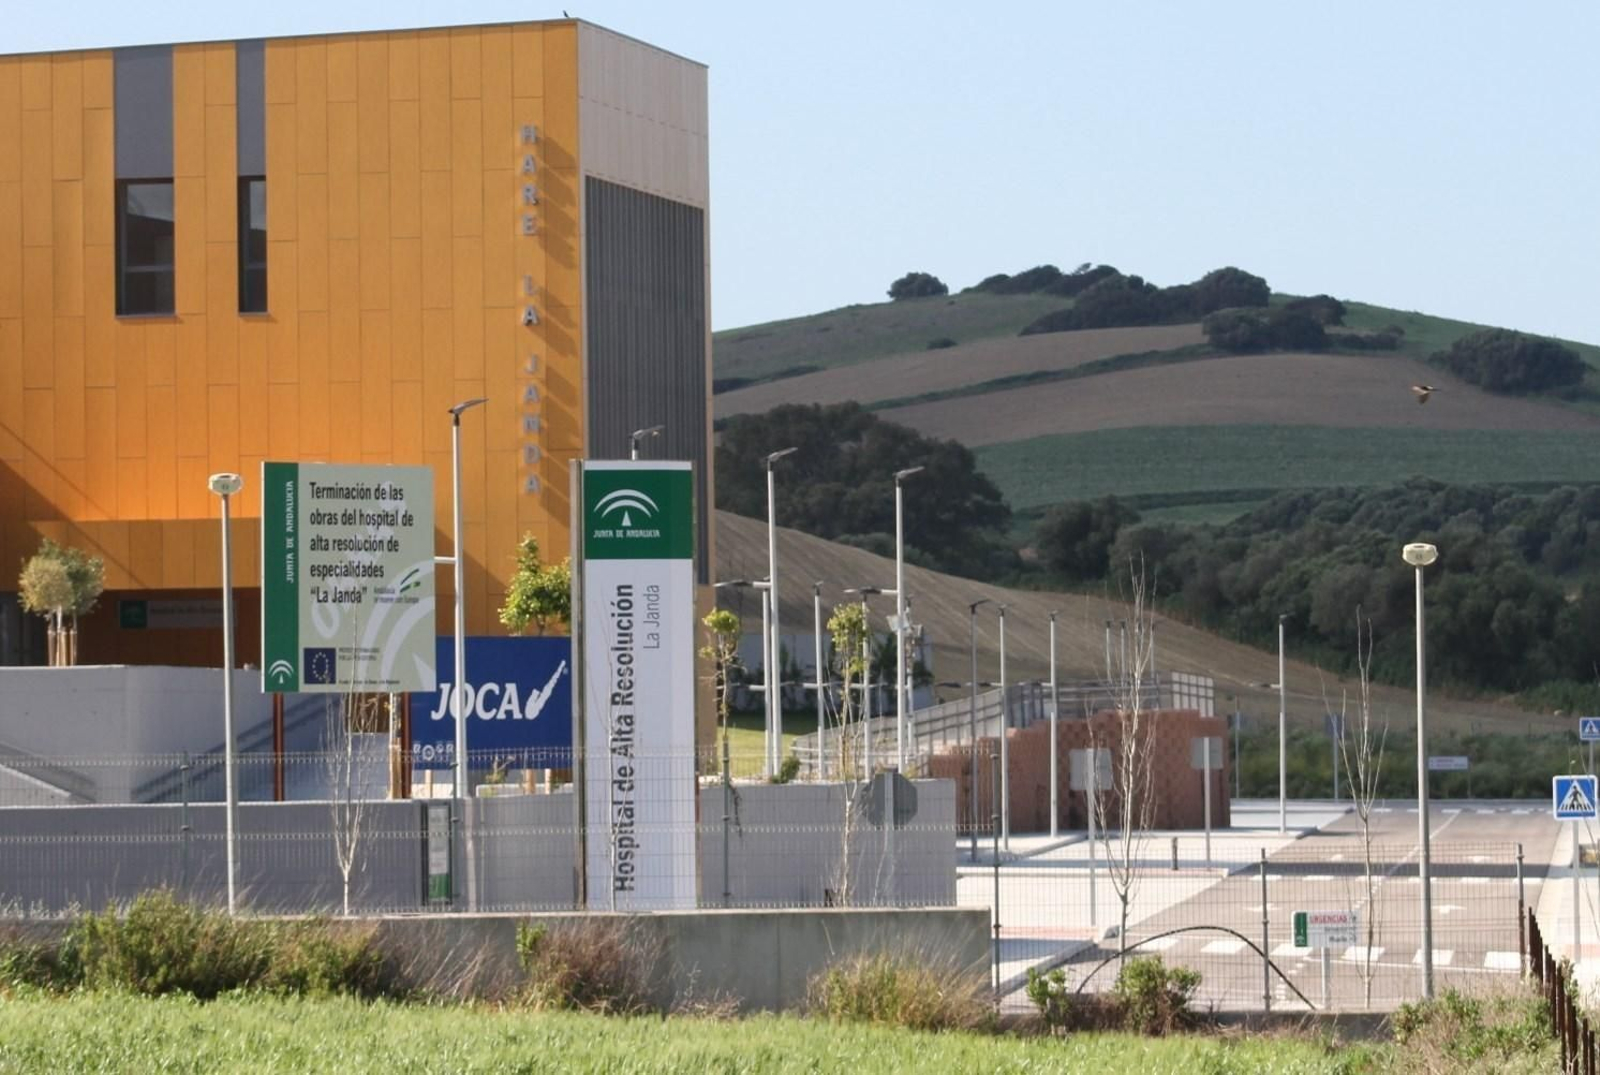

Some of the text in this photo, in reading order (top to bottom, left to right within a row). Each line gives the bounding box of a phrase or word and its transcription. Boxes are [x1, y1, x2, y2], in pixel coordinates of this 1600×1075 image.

[520, 124, 540, 495] HARE LA JANDA
[309, 481, 404, 501] Terminación de las
[309, 508, 414, 531] obras del hospital de
[285, 536, 294, 549] DE
[310, 534, 400, 552] alta resolución de
[593, 529, 614, 539] JUNTA
[615, 529, 624, 539] DE
[285, 552, 294, 584] JUNTA
[310, 560, 385, 581] especialidades
[642, 584, 660, 649] La Janda
[430, 681, 523, 721] JOCA
[610, 583, 640, 891] Hospital de Alta Resolución
